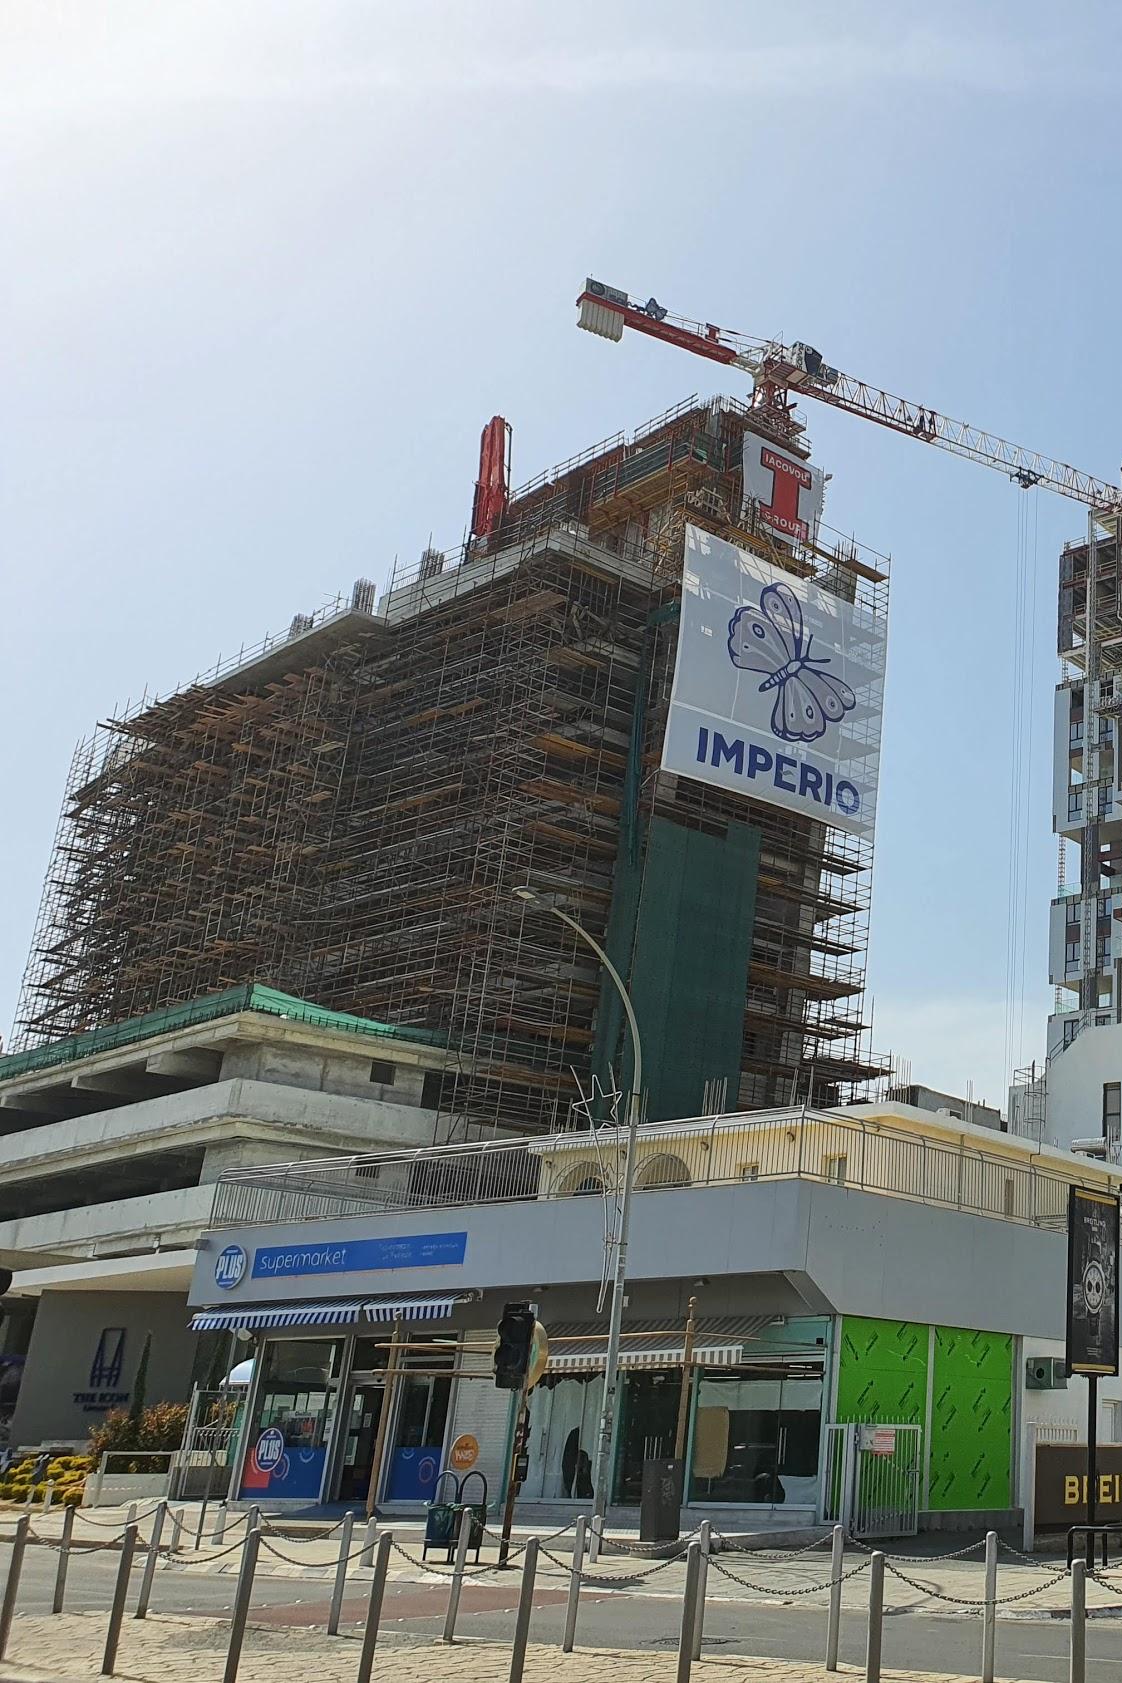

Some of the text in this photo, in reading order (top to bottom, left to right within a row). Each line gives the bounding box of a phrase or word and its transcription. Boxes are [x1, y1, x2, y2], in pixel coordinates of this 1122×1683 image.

[765, 453, 810, 482] IACOVOU
[696, 726, 861, 815] IMPERIO
[215, 1254, 243, 1279] PLUS
[260, 1247, 346, 1275] supermarket
[258, 1440, 281, 1460] PLUS
